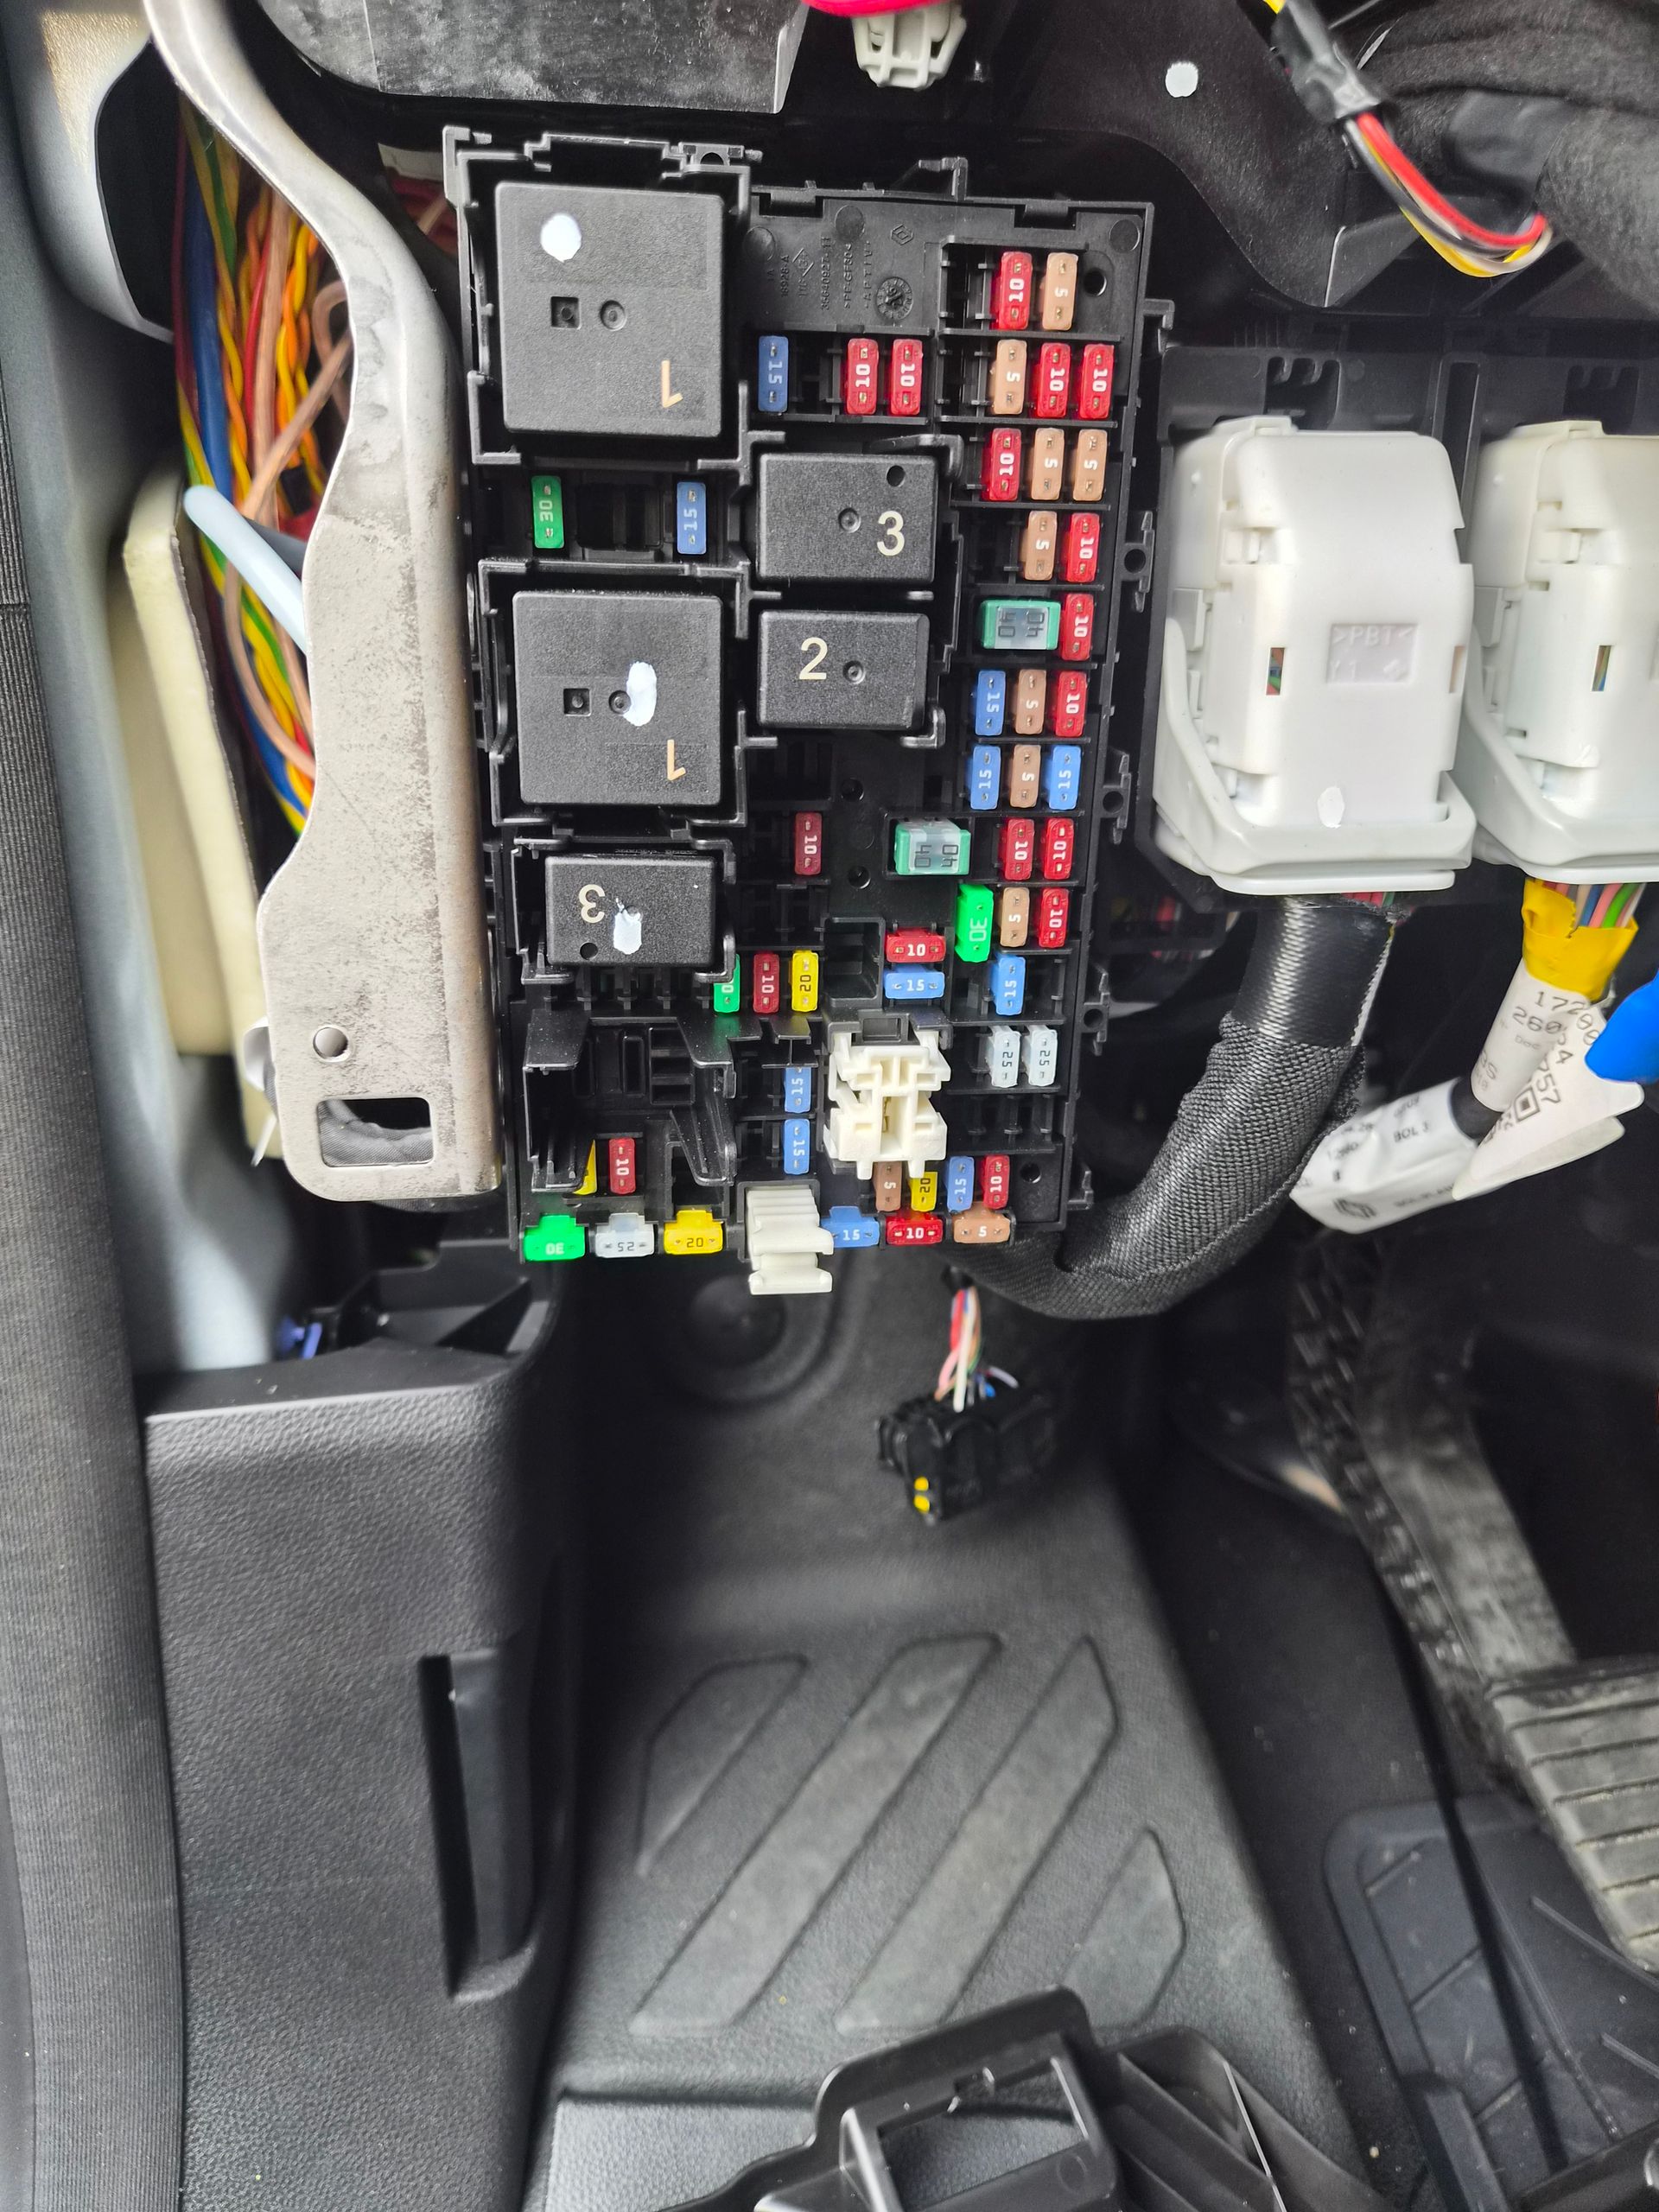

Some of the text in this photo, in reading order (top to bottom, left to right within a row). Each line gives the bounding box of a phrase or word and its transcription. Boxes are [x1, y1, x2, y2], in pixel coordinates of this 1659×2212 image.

[1009, 278, 1024, 302] 10
[1054, 287, 1068, 297] 5
[768, 360, 783, 385] 15
[855, 364, 870, 387] 10
[900, 363, 915, 387] 10
[1007, 372, 1020, 382] 5
[1050, 368, 1065, 391] 10
[1092, 368, 1108, 392] 10
[999, 453, 1014, 475] 10
[1045, 457, 1058, 468] 5
[1084, 459, 1097, 470] 5
[539, 499, 553, 523] 30
[683, 508, 697, 531] 15
[876, 510, 905, 556] 3
[1036, 539, 1050, 550] 5
[1079, 537, 1094, 559] 10
[1074, 614, 1089, 638] 10
[798, 637, 829, 680] 2
[987, 692, 1000, 713] 15
[1026, 699, 1039, 709] 5
[1066, 693, 1080, 714] 10
[979, 769, 992, 789] 15
[1021, 772, 1035, 782] 5
[1058, 769, 1071, 789] 15
[804, 835, 817, 855] 10
[1014, 841, 1028, 861] 10
[1052, 841, 1067, 861] 10
[578, 884, 606, 924] 3
[1008, 913, 1021, 923] 5
[1049, 909, 1063, 928] 10
[969, 918, 988, 942] 30
[907, 943, 925, 957] 10
[761, 975, 775, 994] 10
[907, 979, 925, 991] 15
[1005, 980, 1017, 997] 15
[1002, 1052, 1013, 1068] 25
[1039, 1050, 1051, 1066] 25
[791, 1077, 804, 1095] 15
[793, 1140, 805, 1156] 15
[616, 1158, 629, 1176] 10
[884, 1181, 896, 1190] 5
[955, 1178, 967, 1194] 15
[990, 1176, 1002, 1192] 10
[842, 1230, 861, 1241] 15
[906, 1228, 924, 1238] 10
[978, 1226, 988, 1236] 5
[686, 1238, 704, 1248] 20
